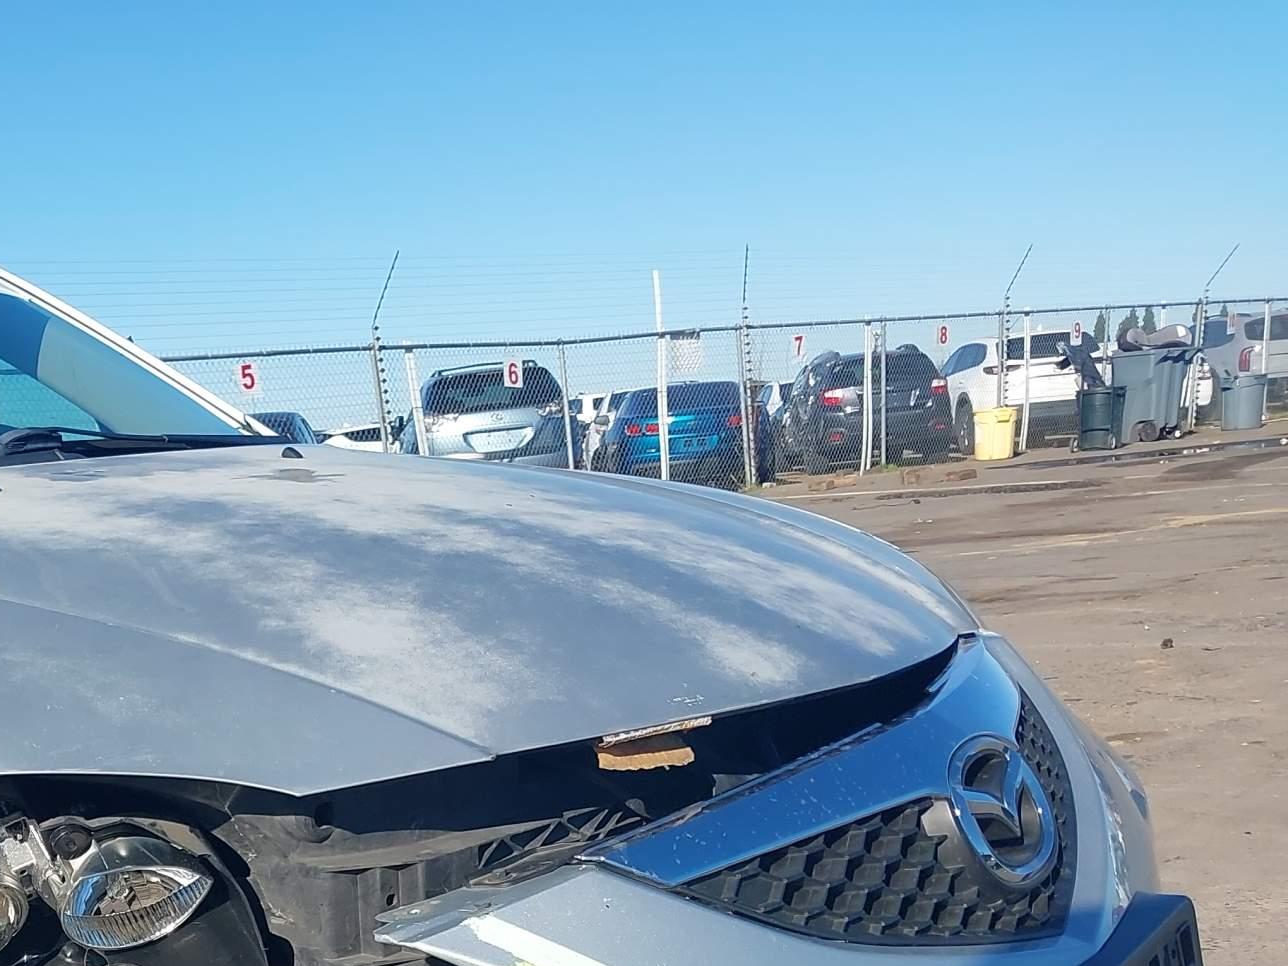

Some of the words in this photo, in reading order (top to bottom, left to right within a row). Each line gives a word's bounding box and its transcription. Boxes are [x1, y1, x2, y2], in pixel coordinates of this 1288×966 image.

[940, 326, 948, 344] 8
[1074, 322, 1081, 339] 9
[794, 335, 804, 356] 7
[241, 364, 255, 390] 5
[508, 362, 518, 385] 6
